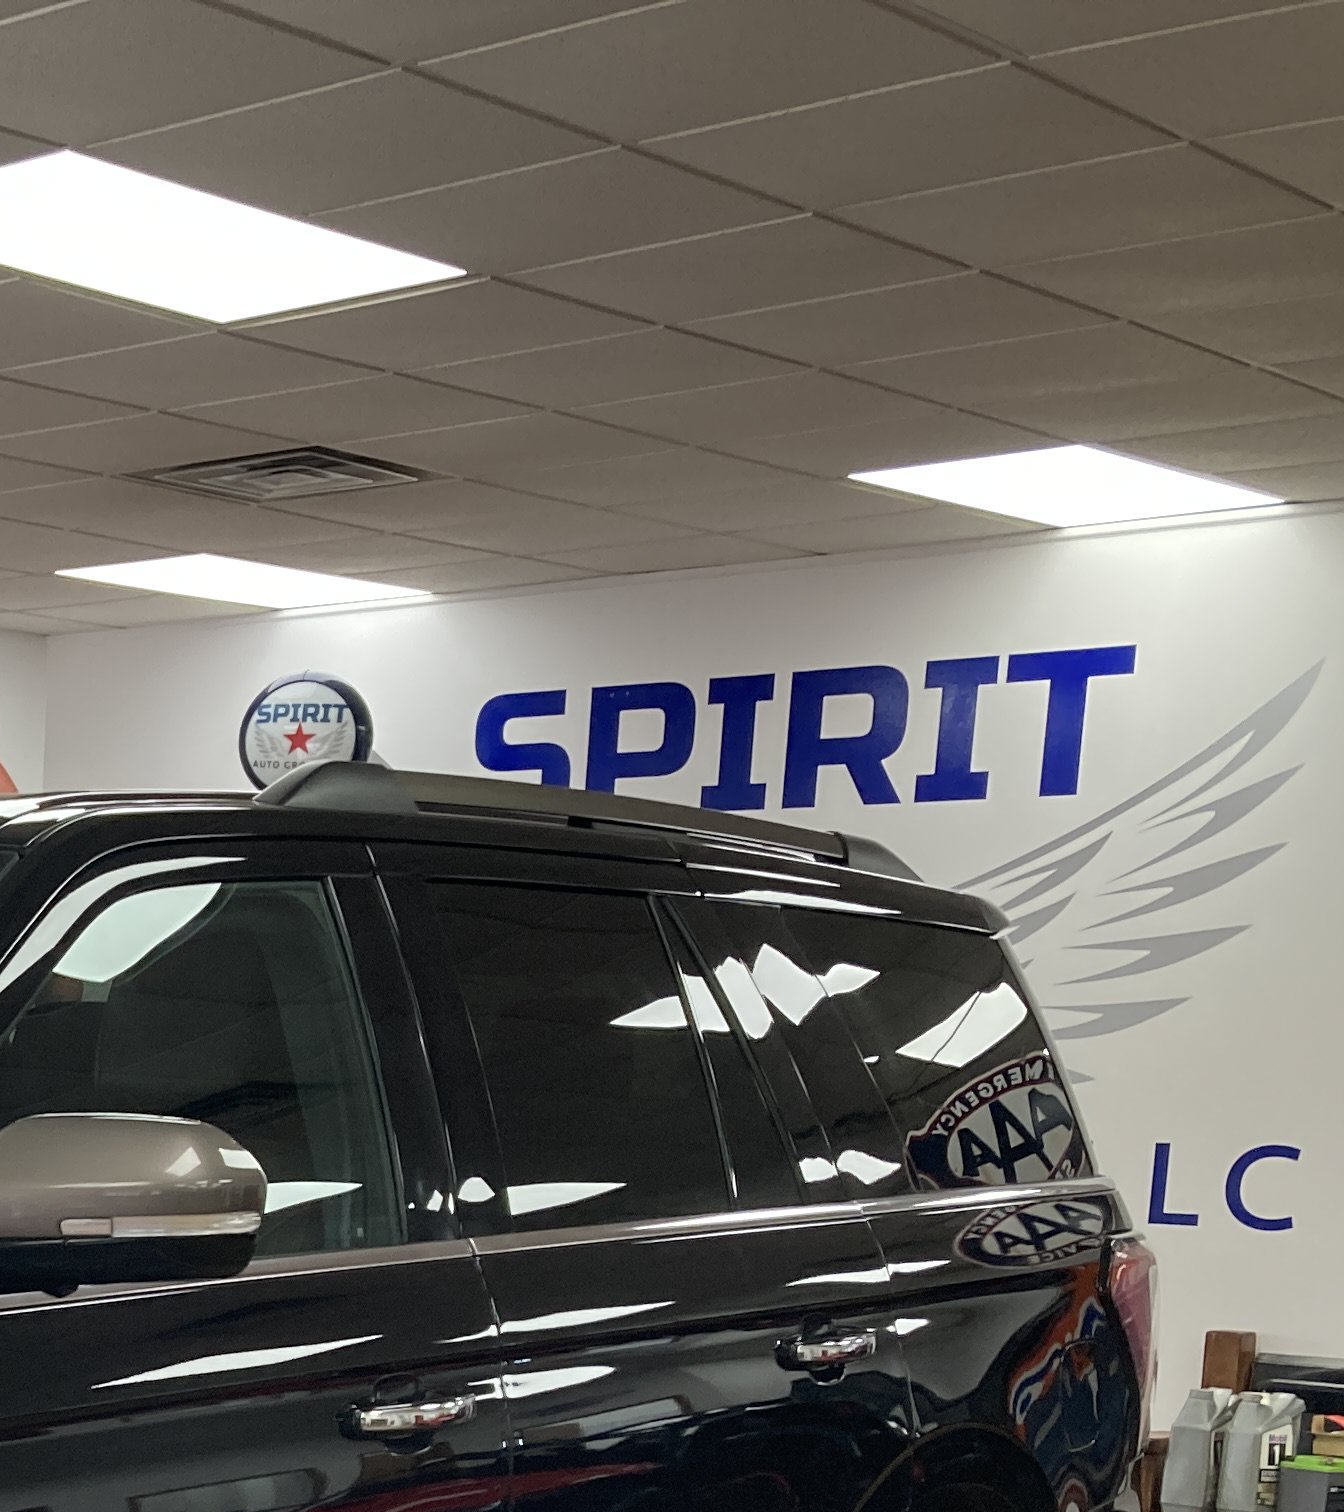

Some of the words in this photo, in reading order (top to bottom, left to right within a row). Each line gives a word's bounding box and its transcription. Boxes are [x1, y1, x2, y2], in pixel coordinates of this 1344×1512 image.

[255, 703, 350, 724] SPIRIT
[475, 644, 1138, 811] SPIRIT
[253, 760, 280, 769] AUTO
